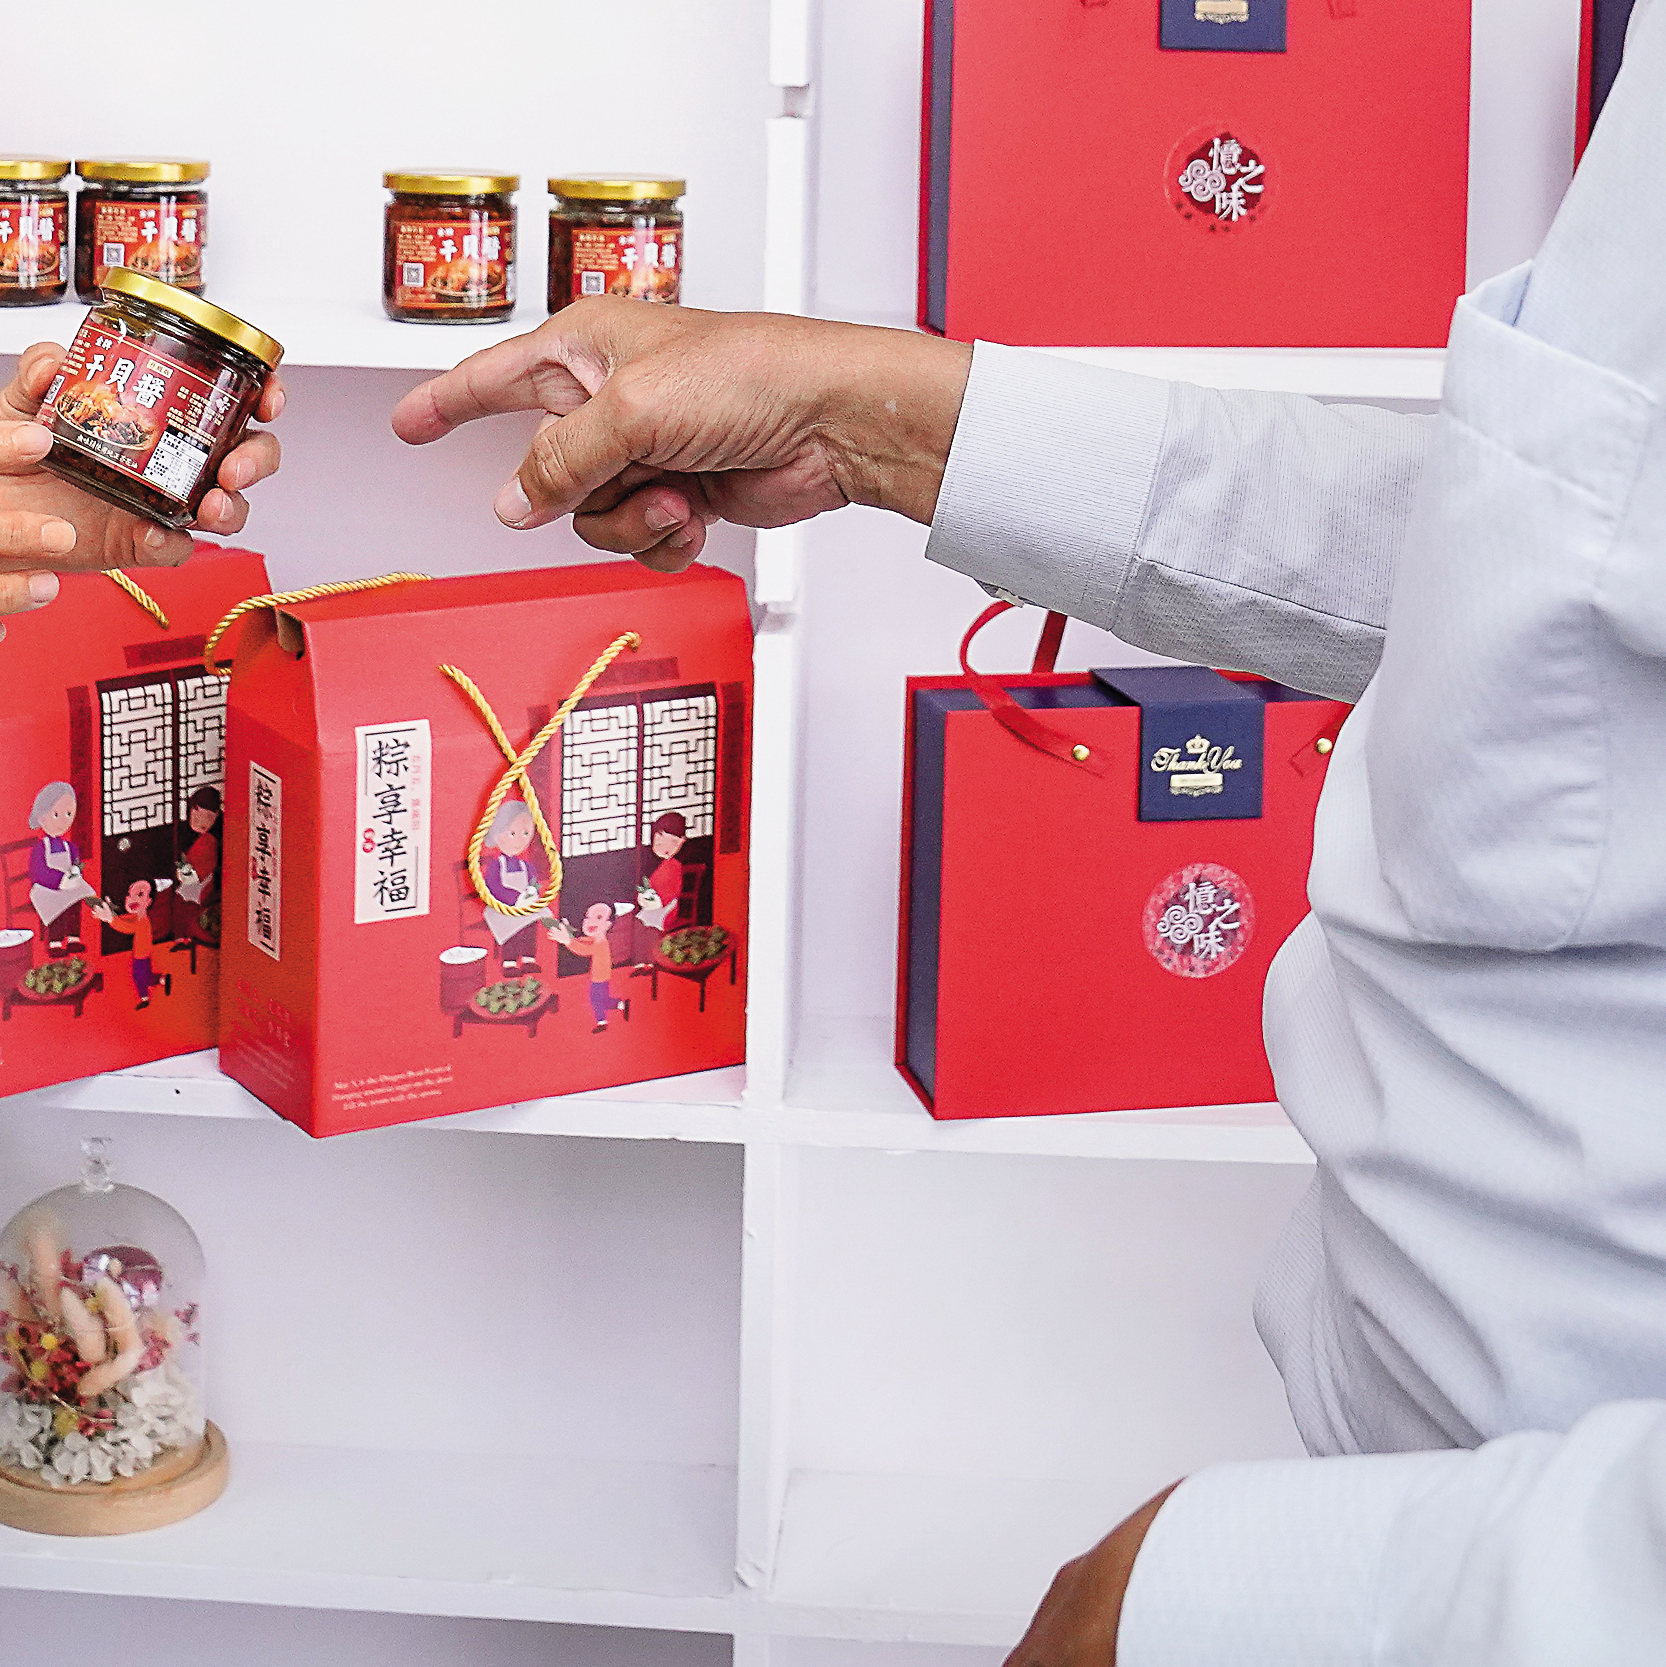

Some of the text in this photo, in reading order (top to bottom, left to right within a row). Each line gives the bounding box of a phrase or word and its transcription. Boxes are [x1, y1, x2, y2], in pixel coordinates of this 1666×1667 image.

[85, 353, 166, 409] 干貝醬
[1150, 745, 1243, 774] Thank You
[371, 737, 411, 906] 粽享幸福
